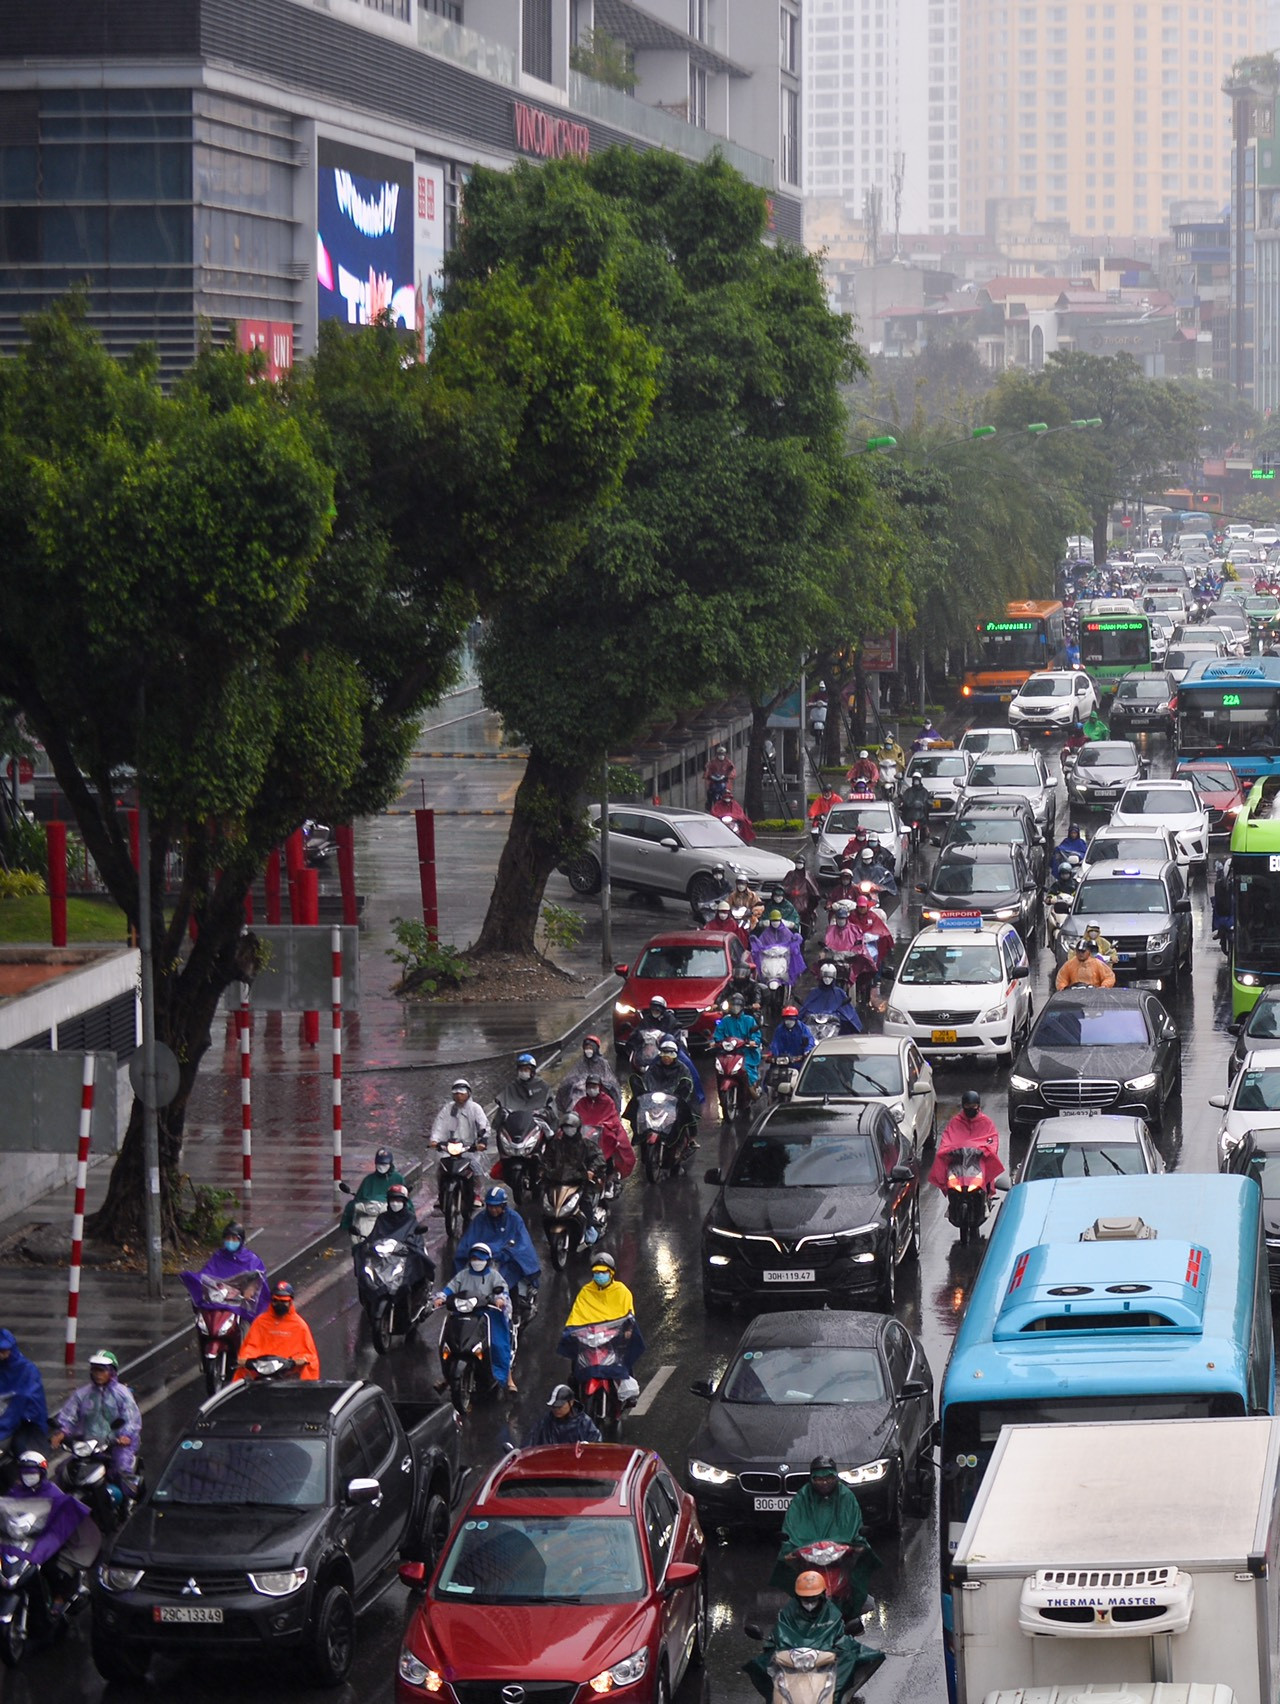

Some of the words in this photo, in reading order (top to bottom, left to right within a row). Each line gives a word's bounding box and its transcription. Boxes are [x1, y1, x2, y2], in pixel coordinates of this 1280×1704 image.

[1223, 695, 1240, 706] 22A
[1047, 1599, 1104, 1607] THERMAL
[1108, 1597, 1157, 1606] MASTER
